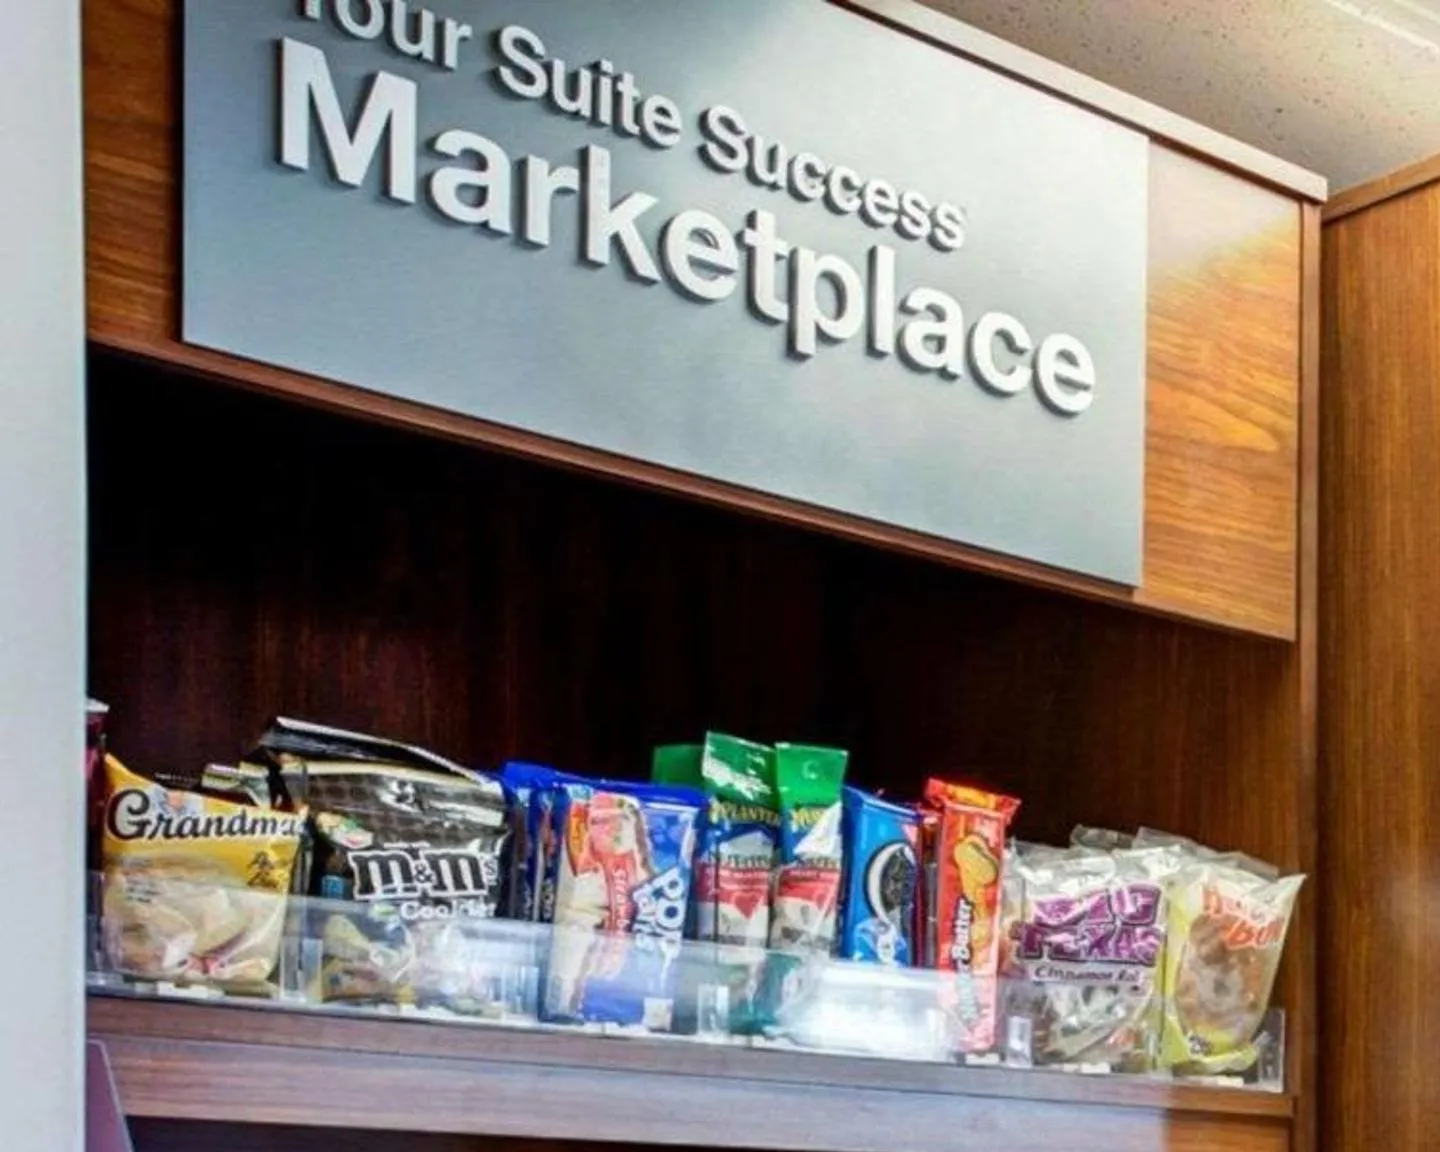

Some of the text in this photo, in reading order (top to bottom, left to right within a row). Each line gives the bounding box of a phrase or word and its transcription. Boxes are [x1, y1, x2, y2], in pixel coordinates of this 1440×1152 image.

[279, 36, 1097, 416] Marketplace
[499, 24, 683, 147] Suite
[699, 106, 967, 250] Success
